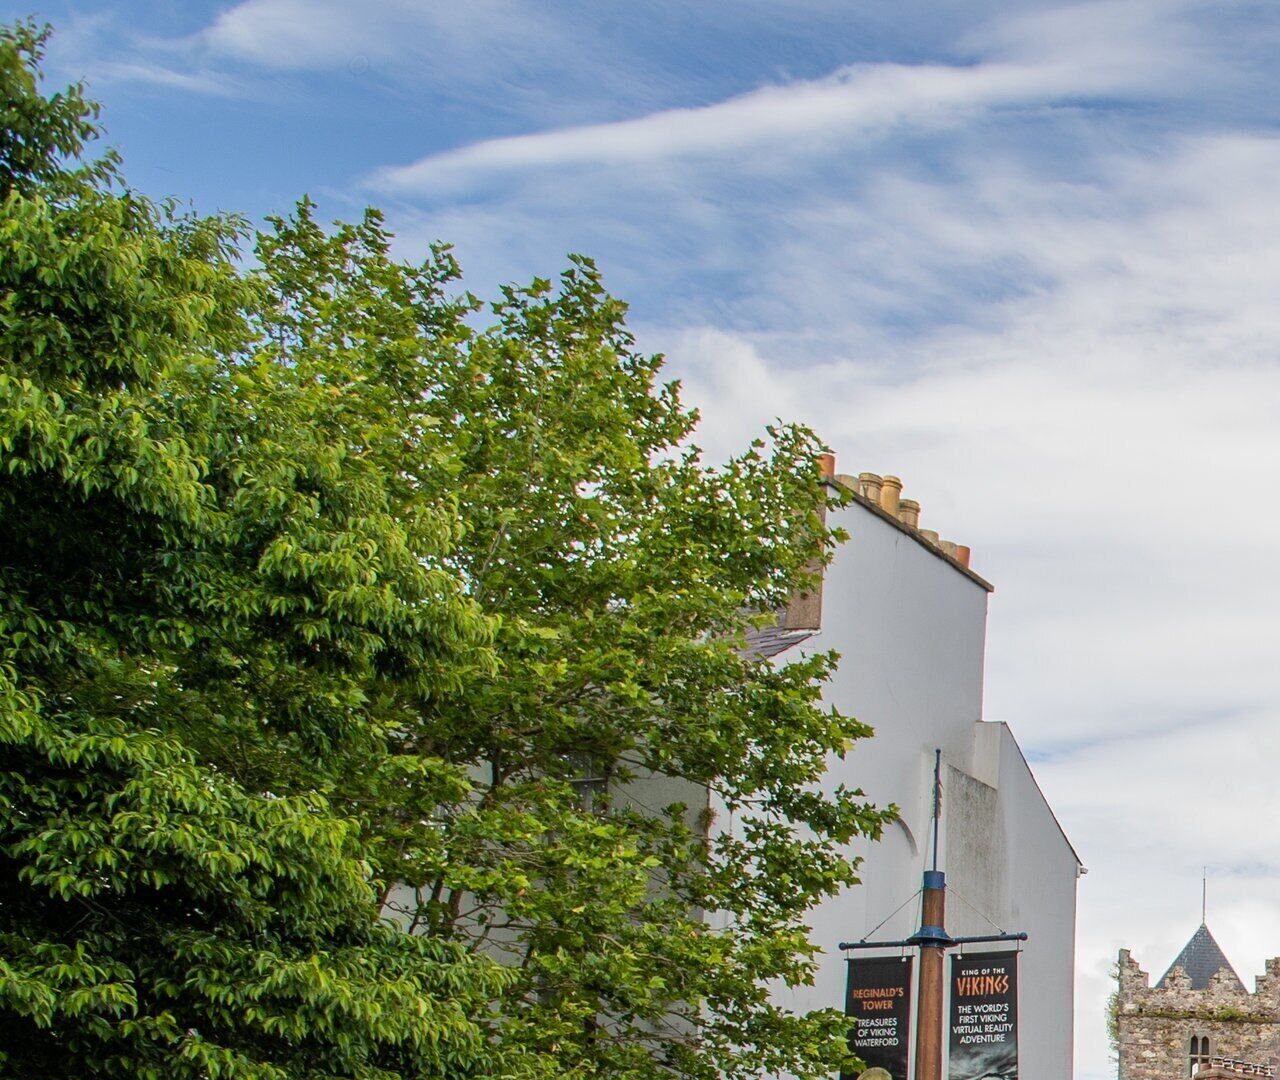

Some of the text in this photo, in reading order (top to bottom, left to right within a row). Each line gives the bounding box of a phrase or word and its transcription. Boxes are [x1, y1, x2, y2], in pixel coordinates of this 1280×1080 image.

[957, 975, 1009, 996] VIKINGS
[853, 988, 904, 999] REGINALD'S
[862, 1001, 893, 1010] TOWER
[958, 1003, 1009, 1014] THE WORLD'S
[858, 1017, 897, 1027] TREASURES
[959, 1013, 1007, 1023] FIRST VIKING
[857, 1027, 896, 1037] OF VIKING
[952, 1023, 1013, 1034] VIRTUAL REALITY
[854, 1038, 899, 1047] WATERFORD
[960, 1034, 1005, 1044] ADVENTURE
